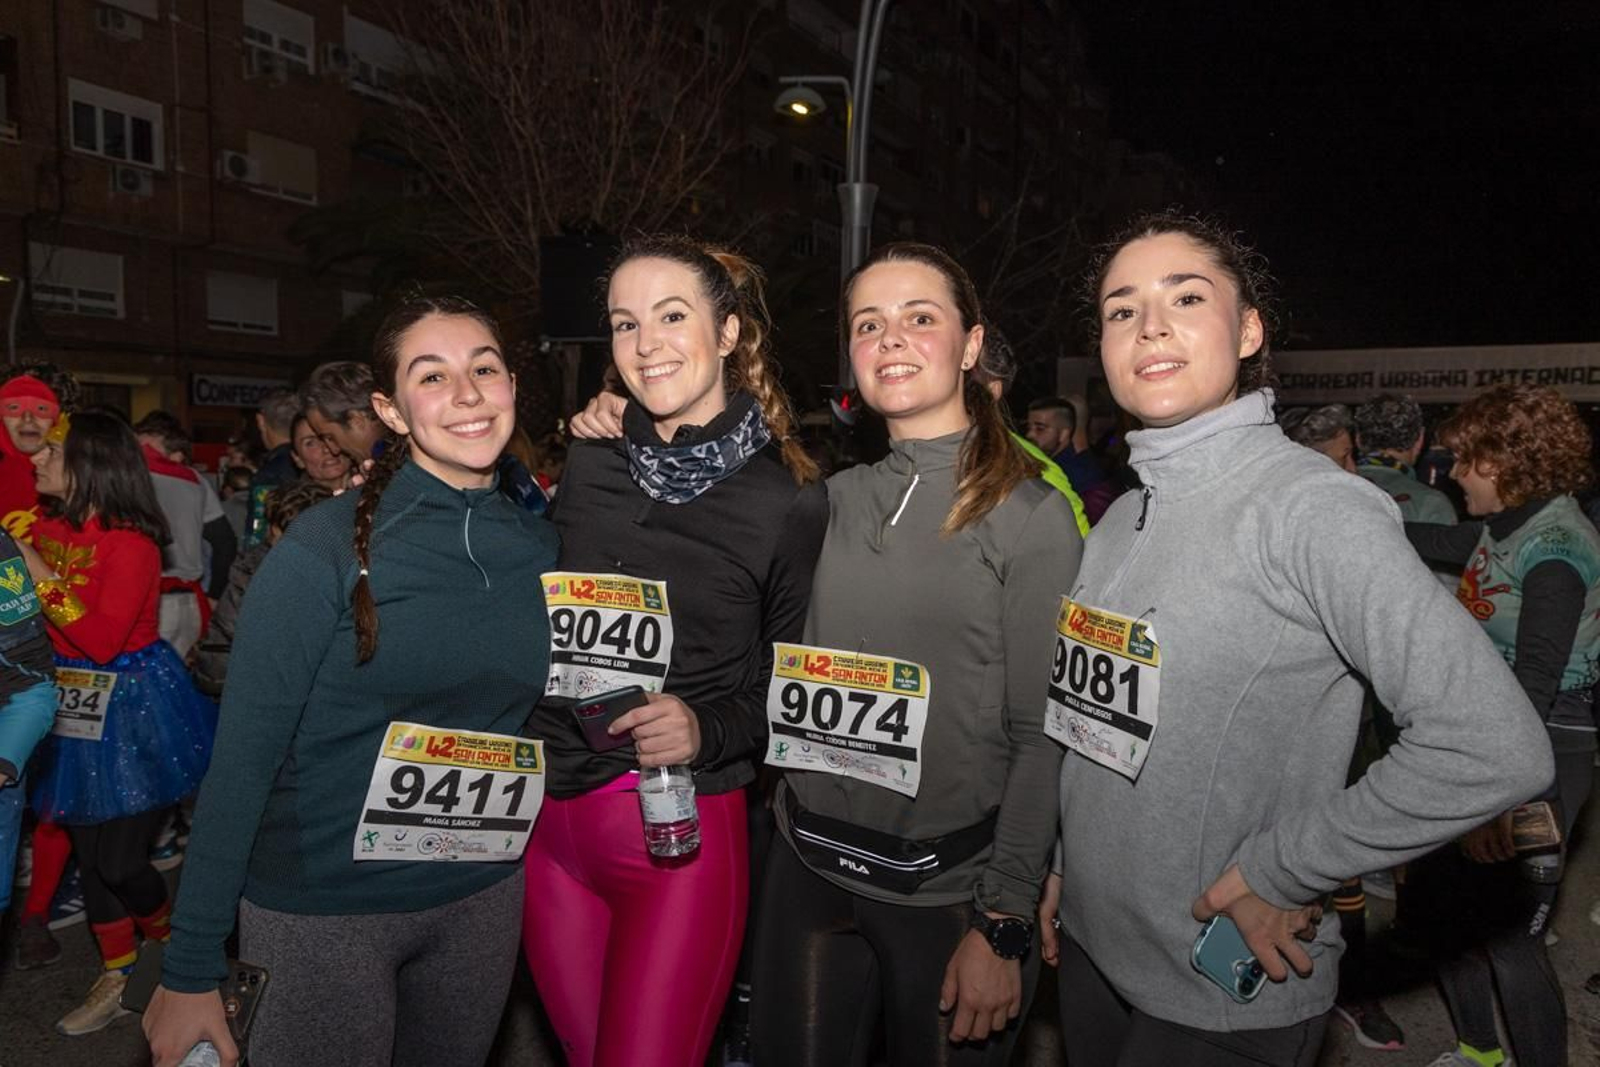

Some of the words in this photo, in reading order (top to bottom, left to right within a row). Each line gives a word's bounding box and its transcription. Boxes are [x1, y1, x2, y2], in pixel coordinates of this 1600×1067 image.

[1281, 372, 1374, 390] CARRERA
[1379, 369, 1468, 388] URBANA
[569, 579, 596, 599] 42
[550, 607, 662, 659] 9040
[803, 654, 832, 678] 42
[831, 668, 852, 679] SAN
[853, 671, 888, 684] ANTON
[1051, 637, 1140, 716] 9081
[780, 682, 909, 743] 9074
[426, 735, 456, 759] 42
[452, 748, 474, 761] SAN
[475, 751, 512, 764] ANTON
[385, 765, 527, 817] 9411
[839, 857, 870, 876] FILA
